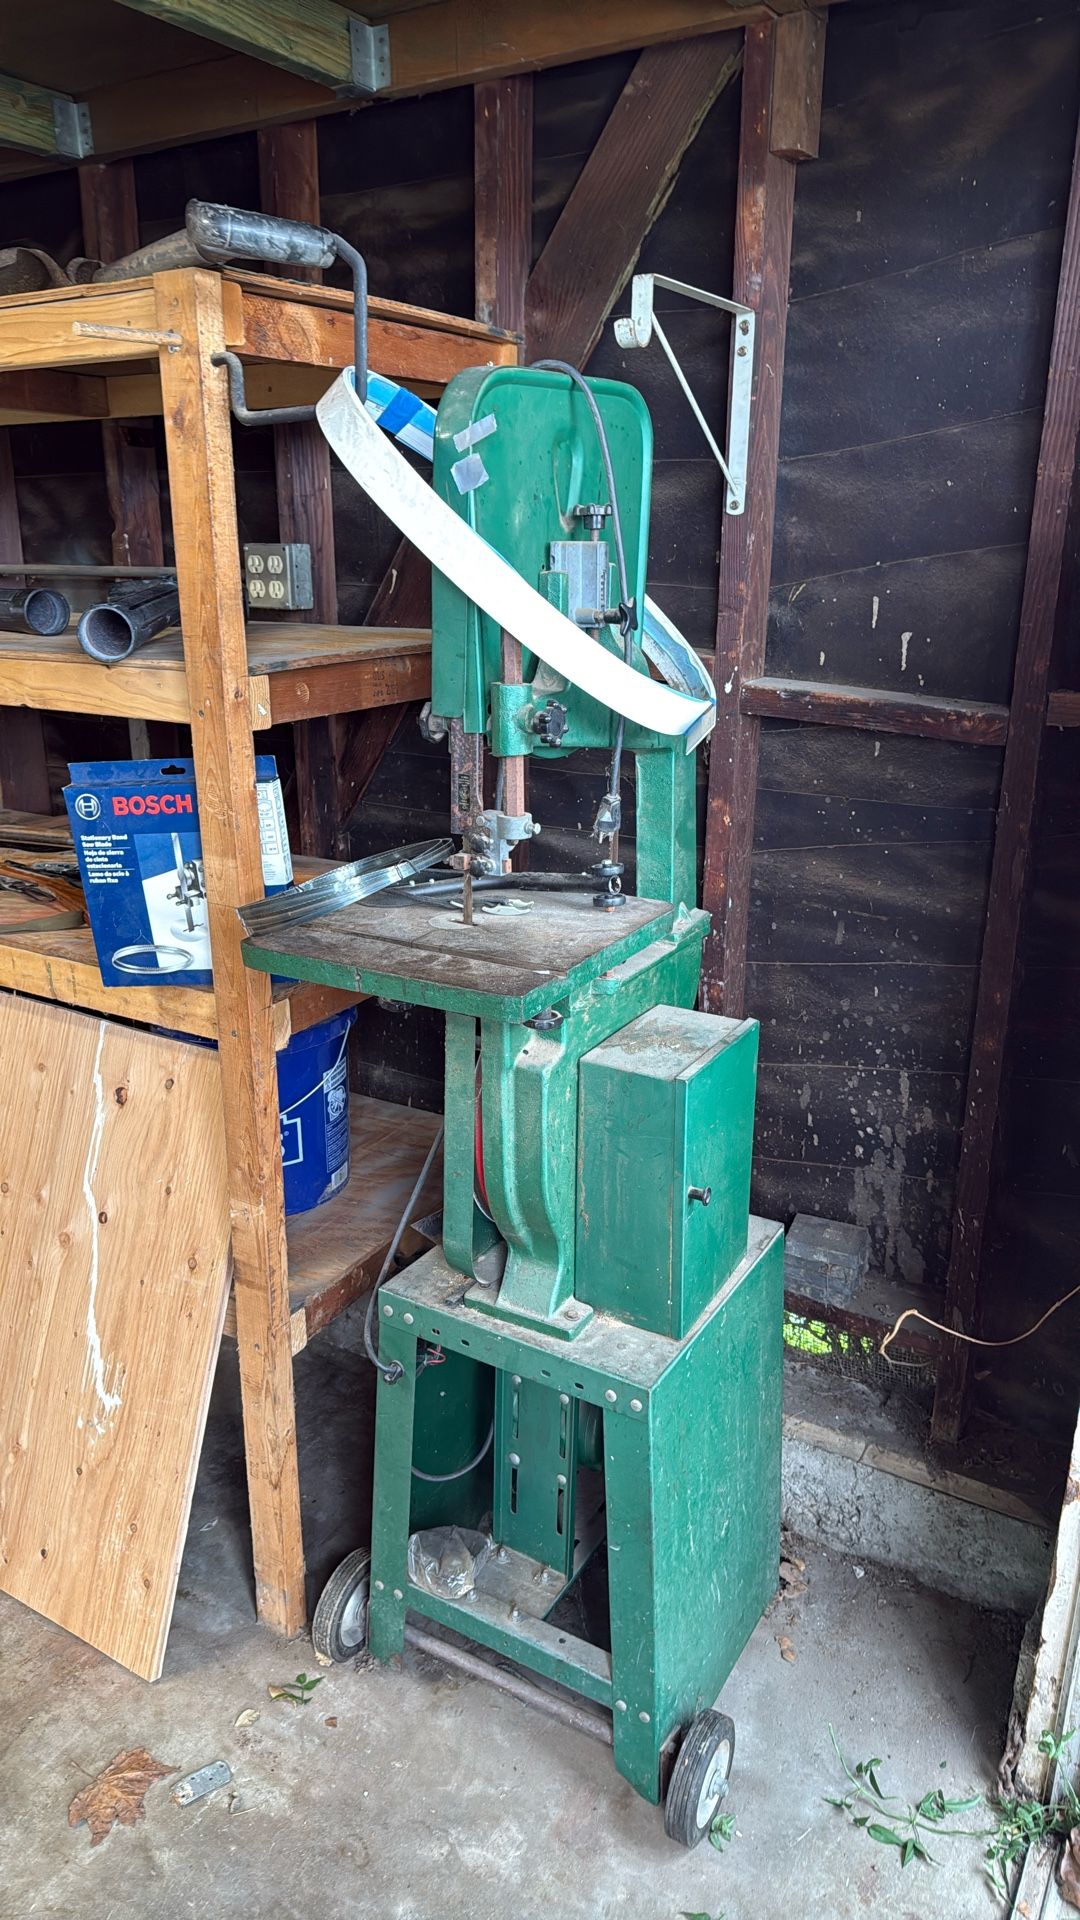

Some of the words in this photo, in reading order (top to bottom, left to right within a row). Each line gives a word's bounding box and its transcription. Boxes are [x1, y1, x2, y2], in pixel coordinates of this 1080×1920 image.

[112, 794, 193, 816] BOSCH
[80, 834, 111, 842] Stationary
[111, 833, 128, 841] Band
[83, 849, 98, 857] Hoja
